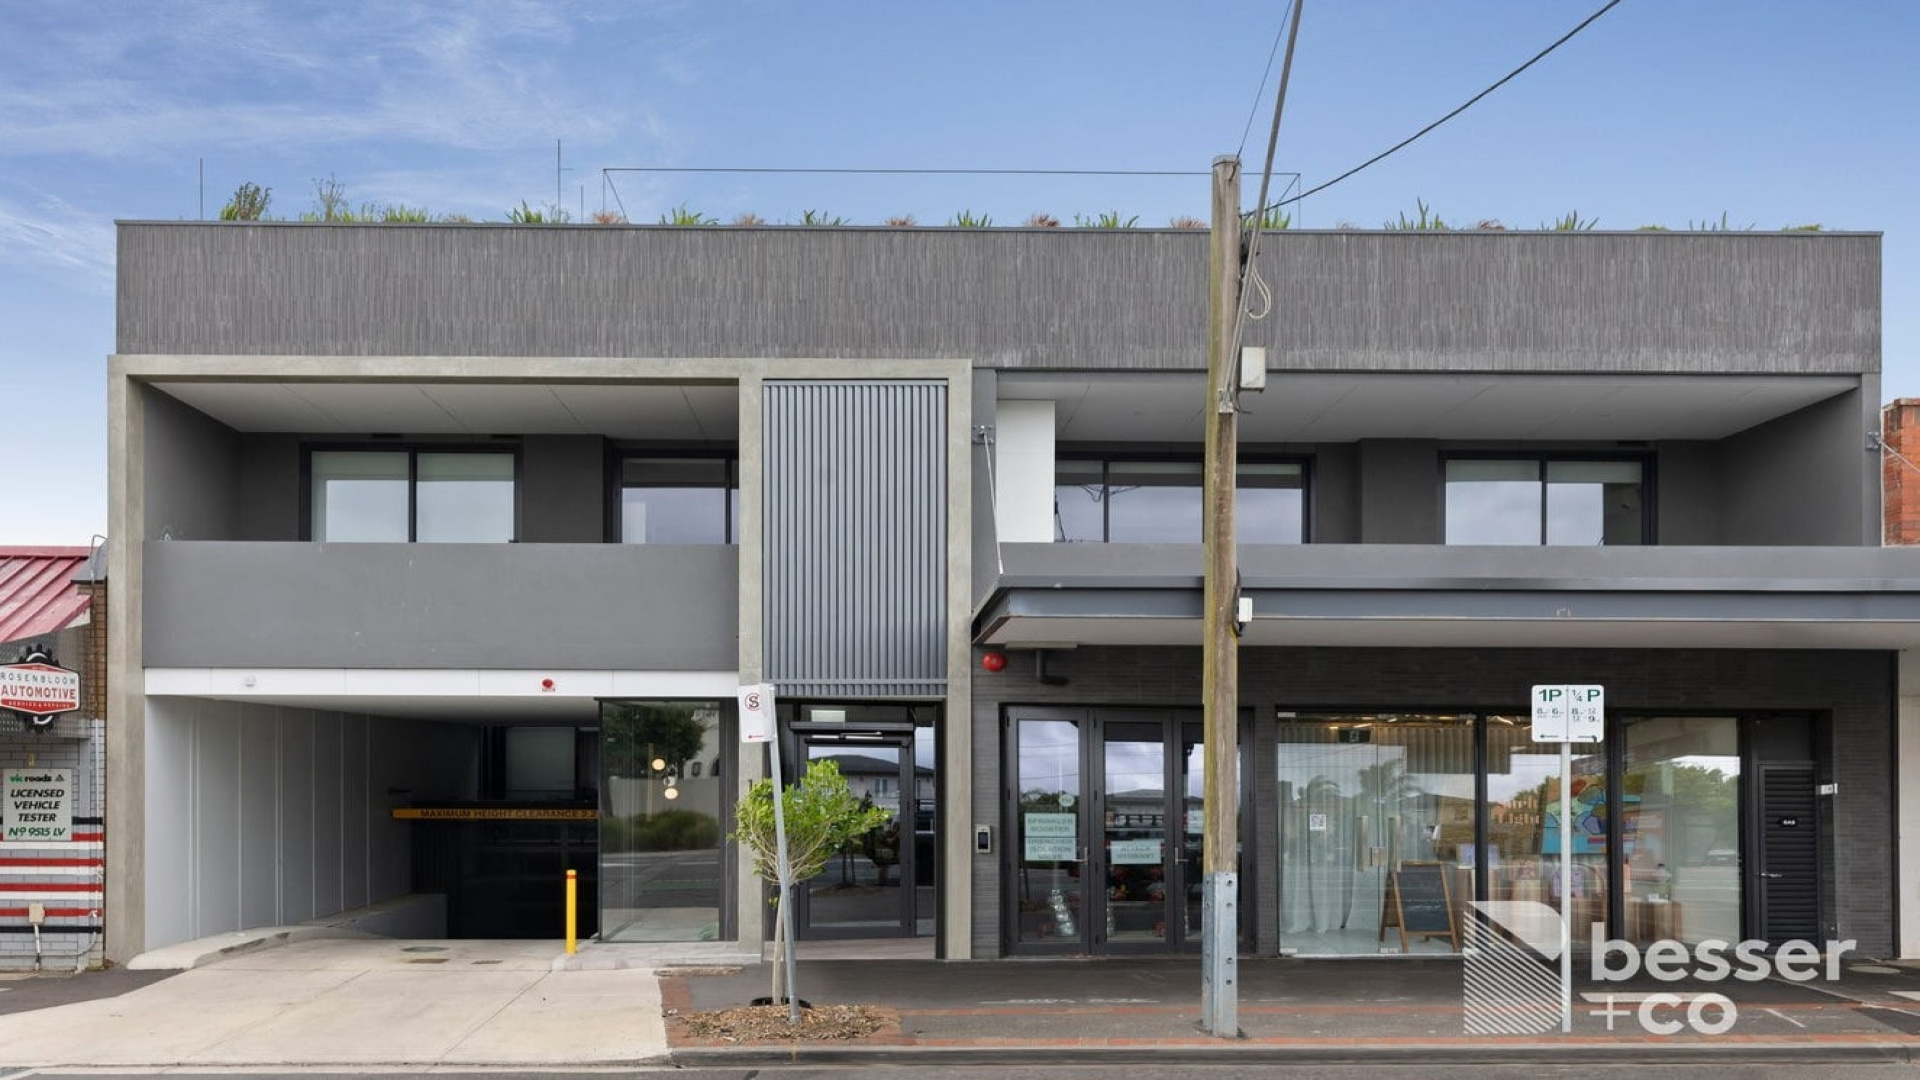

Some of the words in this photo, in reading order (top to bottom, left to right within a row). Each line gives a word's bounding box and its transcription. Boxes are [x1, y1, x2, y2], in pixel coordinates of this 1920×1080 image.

[1, 684, 76, 699] AUTOMOTIVE
[1538, 689, 1562, 702] 1P
[748, 695, 760, 708] S
[10, 788, 65, 798] LICENSED
[14, 800, 61, 810] VEHICLE
[18, 812, 57, 822] TESTER
[420, 809, 470, 818] MAXIMUM
[474, 809, 514, 818] HEIGHT
[515, 809, 579, 818] CLEARANCE
[28, 827, 51, 836] 9515
[53, 827, 66, 836] LV
